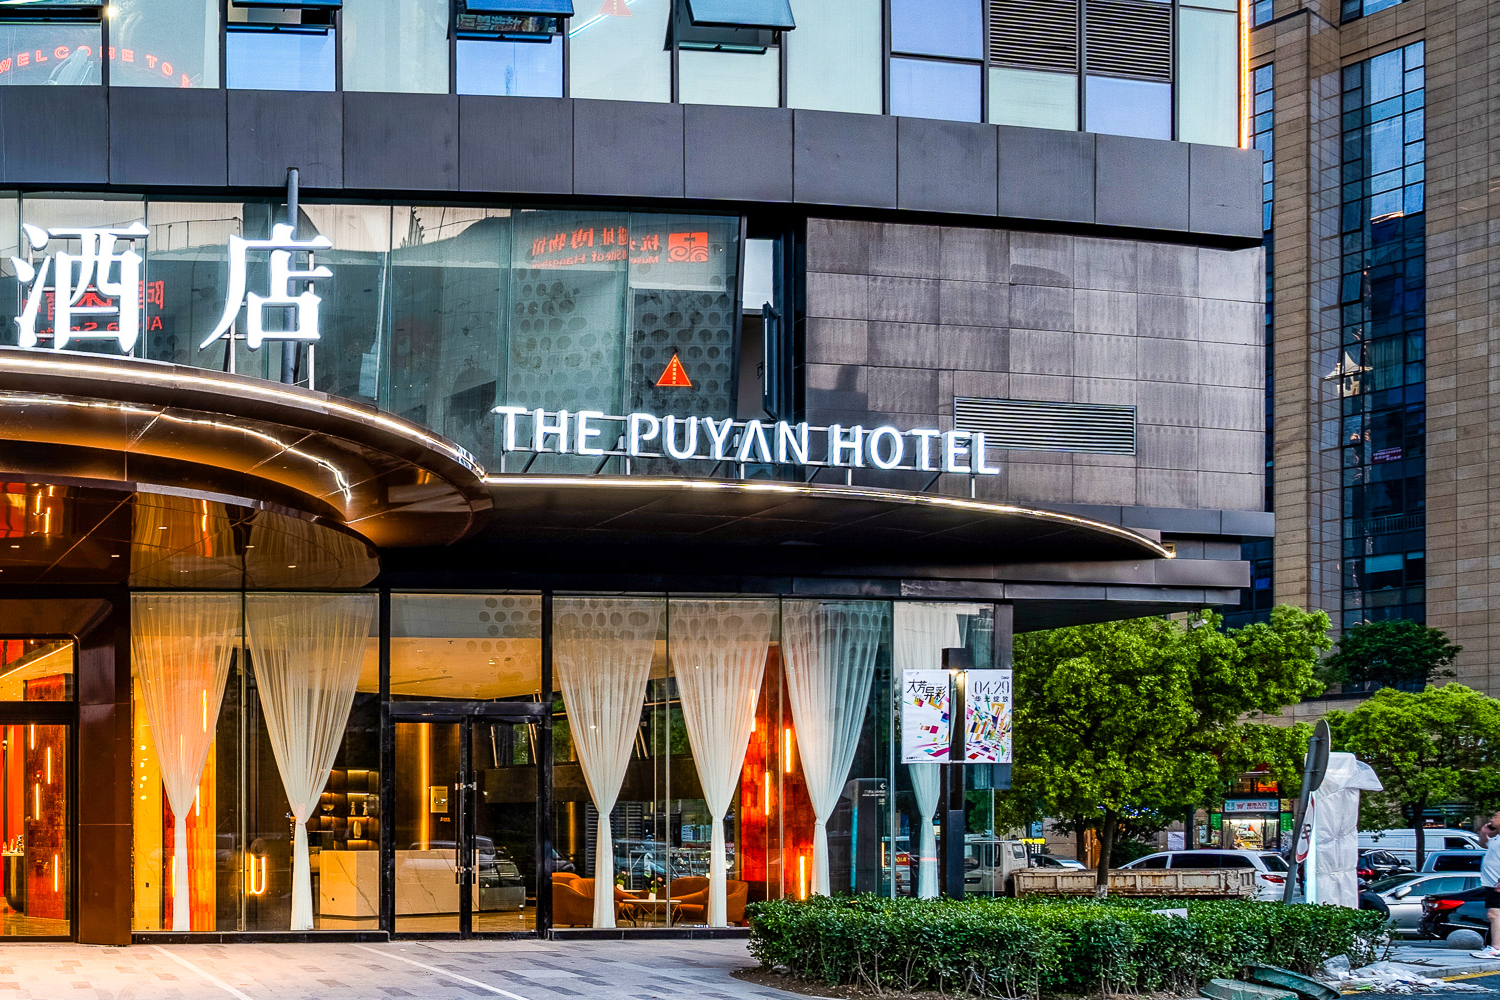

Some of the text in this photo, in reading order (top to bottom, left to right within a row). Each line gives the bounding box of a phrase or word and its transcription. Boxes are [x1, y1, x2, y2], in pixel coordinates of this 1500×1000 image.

[145, 54, 174, 76] TO
[491, 405, 1000, 475] THE PUYAN HOTEL
[974, 680, 1010, 695] 04.29
